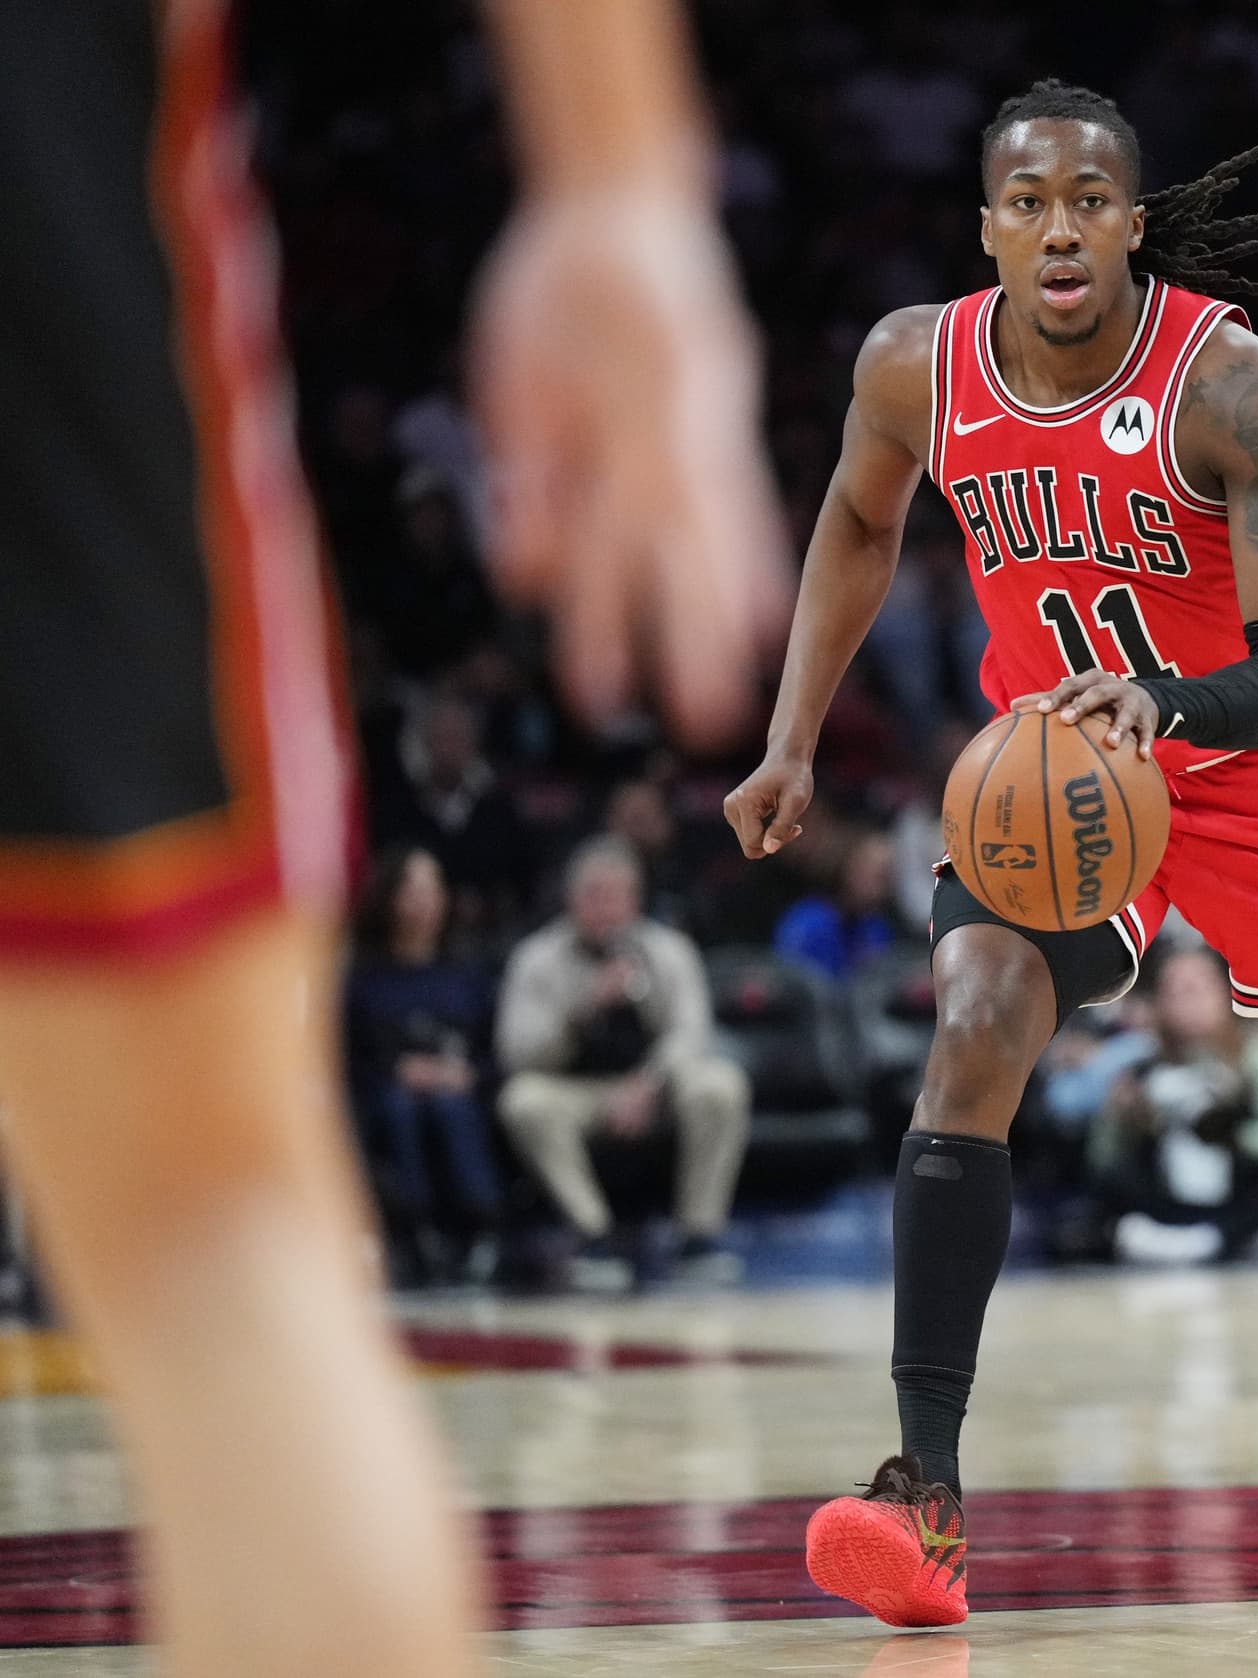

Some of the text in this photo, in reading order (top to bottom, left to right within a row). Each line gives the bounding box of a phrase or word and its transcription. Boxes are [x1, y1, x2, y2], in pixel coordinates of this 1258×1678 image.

[949, 466, 1191, 577] BULLS
[1036, 584, 1182, 681] 11
[1064, 770, 1113, 917] Wilson
